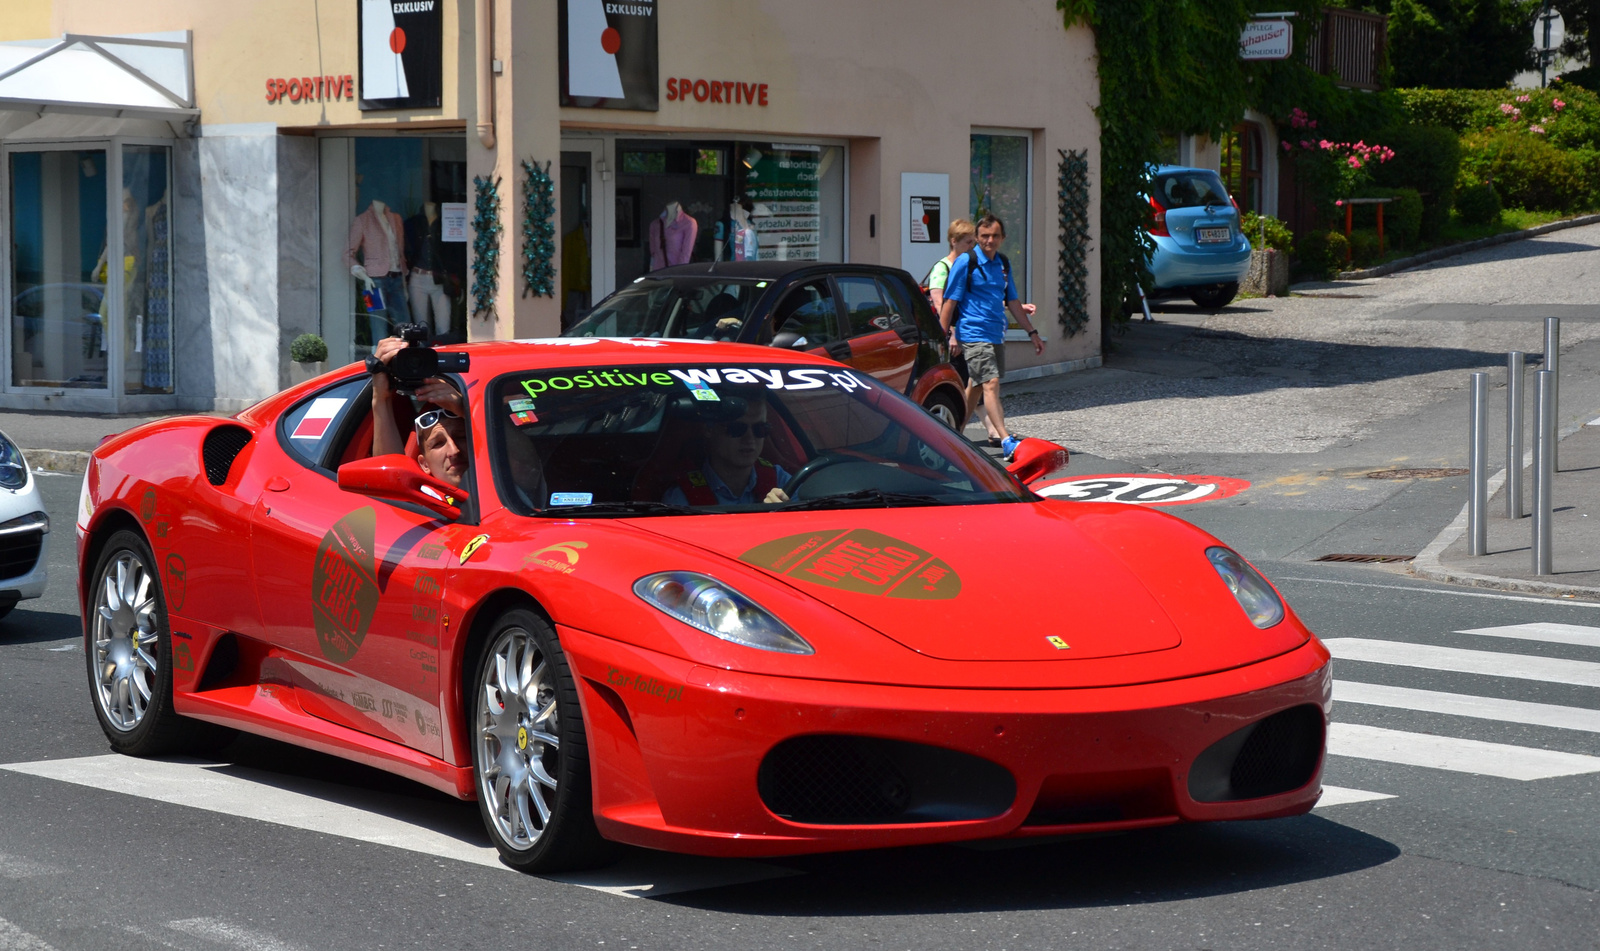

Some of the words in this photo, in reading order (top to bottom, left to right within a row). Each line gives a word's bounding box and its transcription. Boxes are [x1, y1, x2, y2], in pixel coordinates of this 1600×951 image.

[393, 1, 434, 13] EXKLUSIV
[606, 3, 653, 17] EXKLUSIV
[265, 74, 354, 102] SPORTIVE
[666, 77, 769, 106] SPORTIVE
[1046, 481, 1200, 502] 30
[319, 543, 364, 606] MONTE
[804, 539, 881, 583] MONTE
[850, 546, 921, 586] CARLO
[320, 577, 361, 636] CARLO
[409, 648, 436, 664] GoPro
